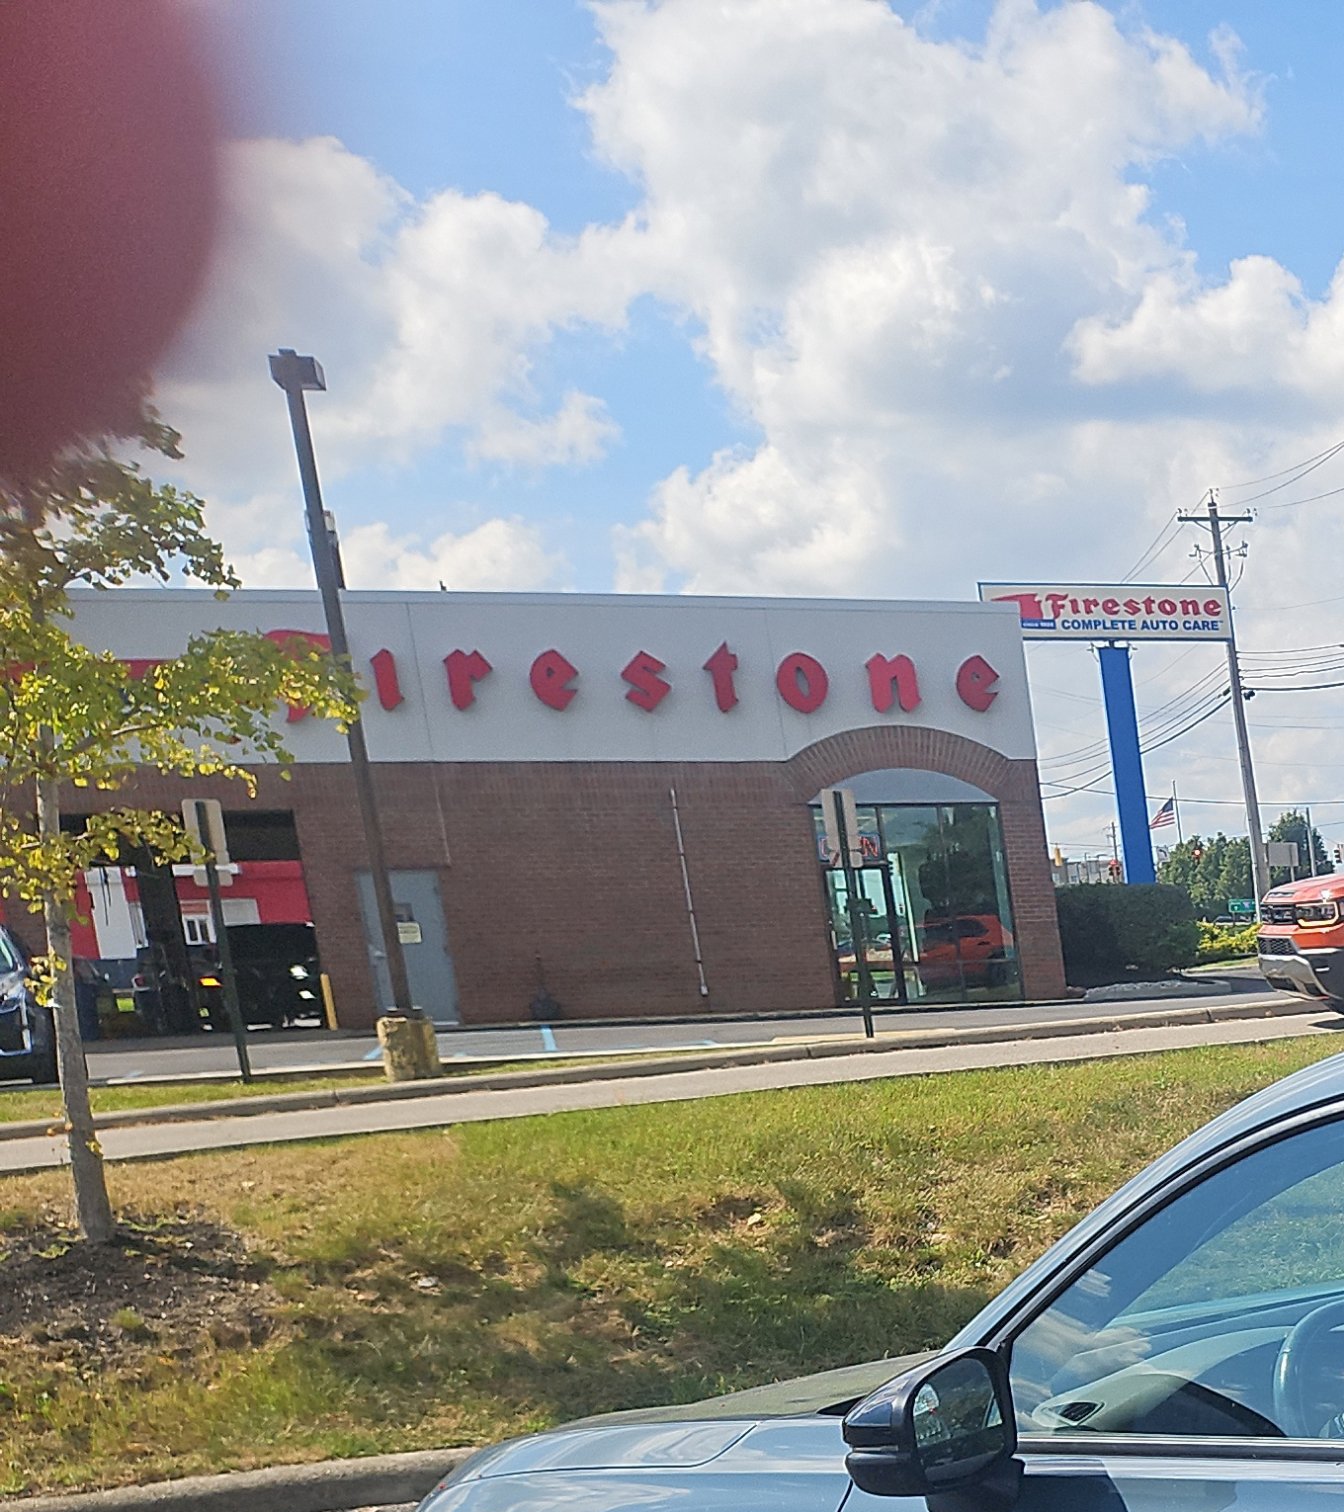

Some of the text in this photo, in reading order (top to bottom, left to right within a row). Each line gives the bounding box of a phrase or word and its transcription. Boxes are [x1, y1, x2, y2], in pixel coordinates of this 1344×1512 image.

[1045, 593, 1222, 619] Firestone
[1061, 619, 1137, 631] COMPLETE
[1141, 619, 1179, 631] AUTO
